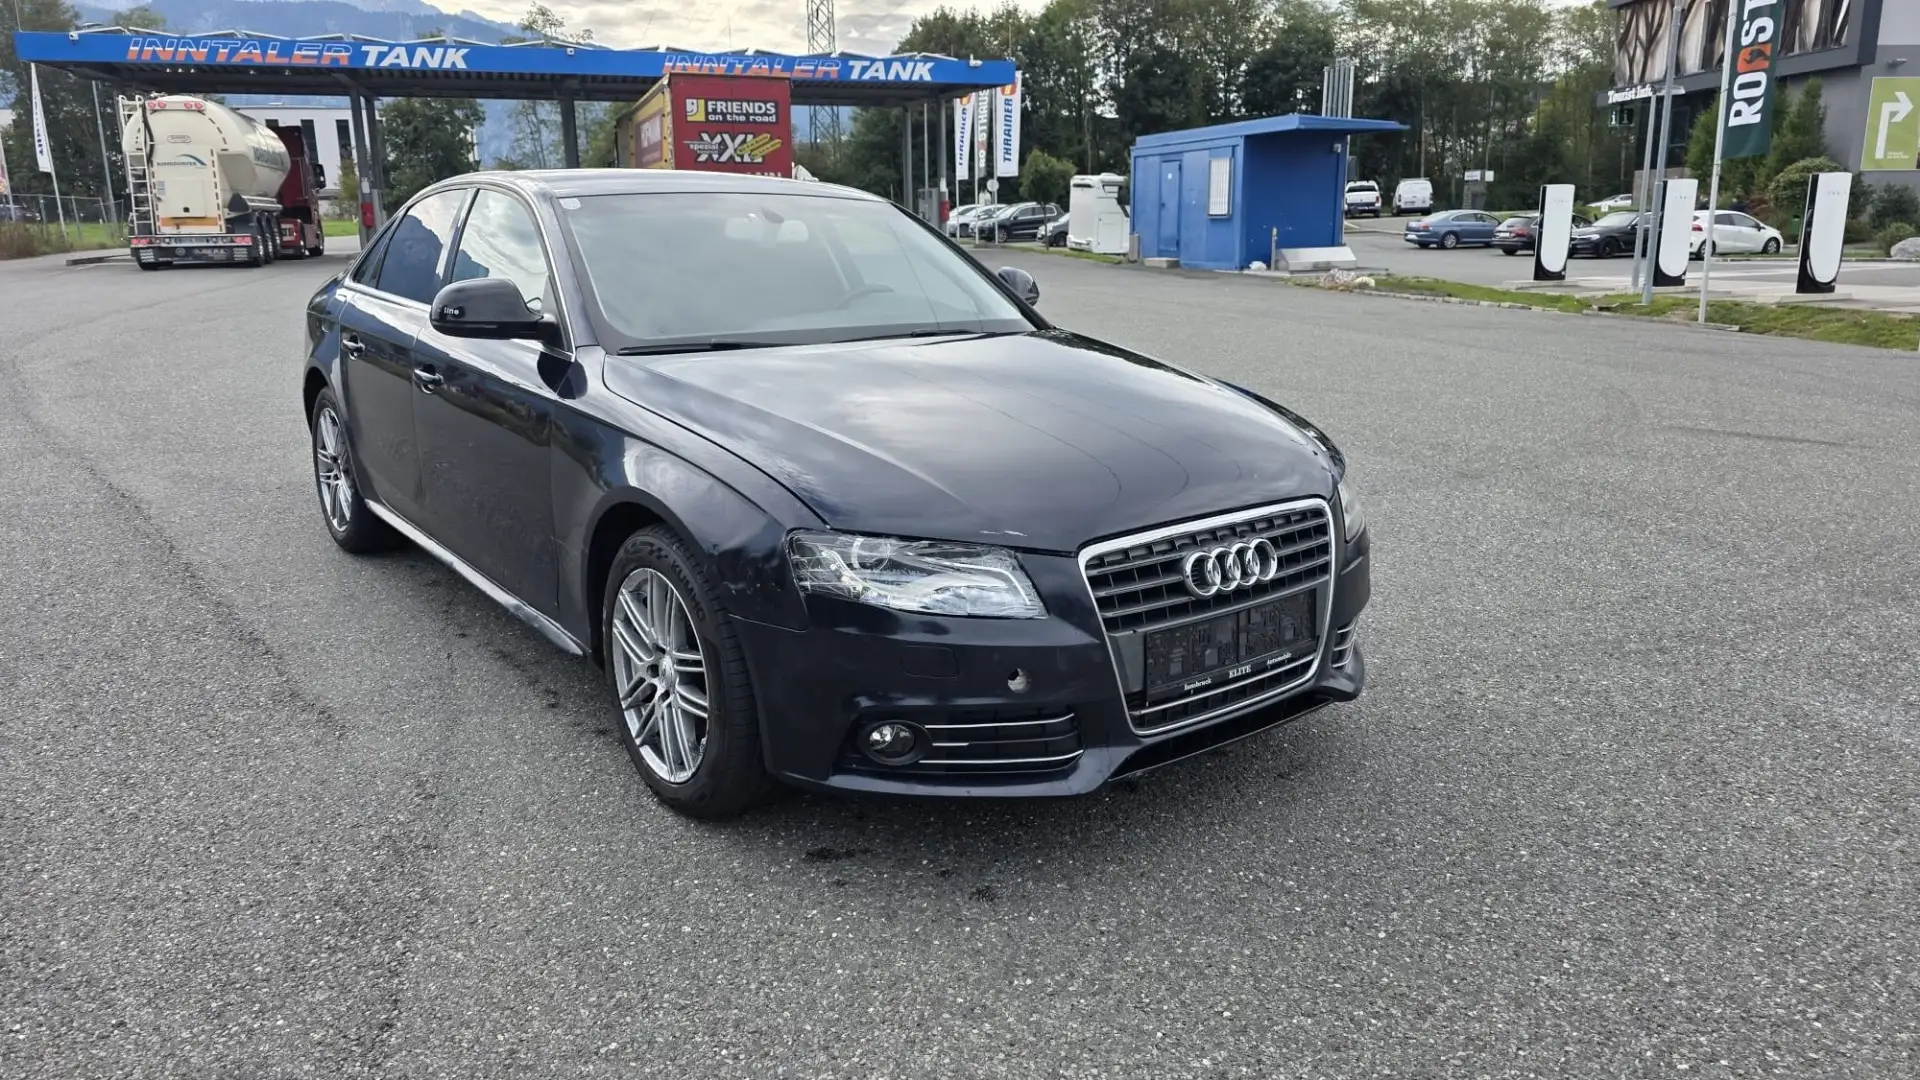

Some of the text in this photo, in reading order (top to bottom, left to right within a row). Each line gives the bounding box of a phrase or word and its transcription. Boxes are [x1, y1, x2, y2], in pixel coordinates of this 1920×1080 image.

[126, 37, 470, 69] INNTALER TANK
[662, 54, 934, 81] INNTALER TANK
[1608, 88, 1636, 104] Tourist
[708, 101, 776, 113] FRIENDS
[727, 114, 746, 122] the
[749, 114, 776, 122] road
[1003, 98, 1013, 163] THRAINER
[1229, 665, 1252, 679] ELITE
